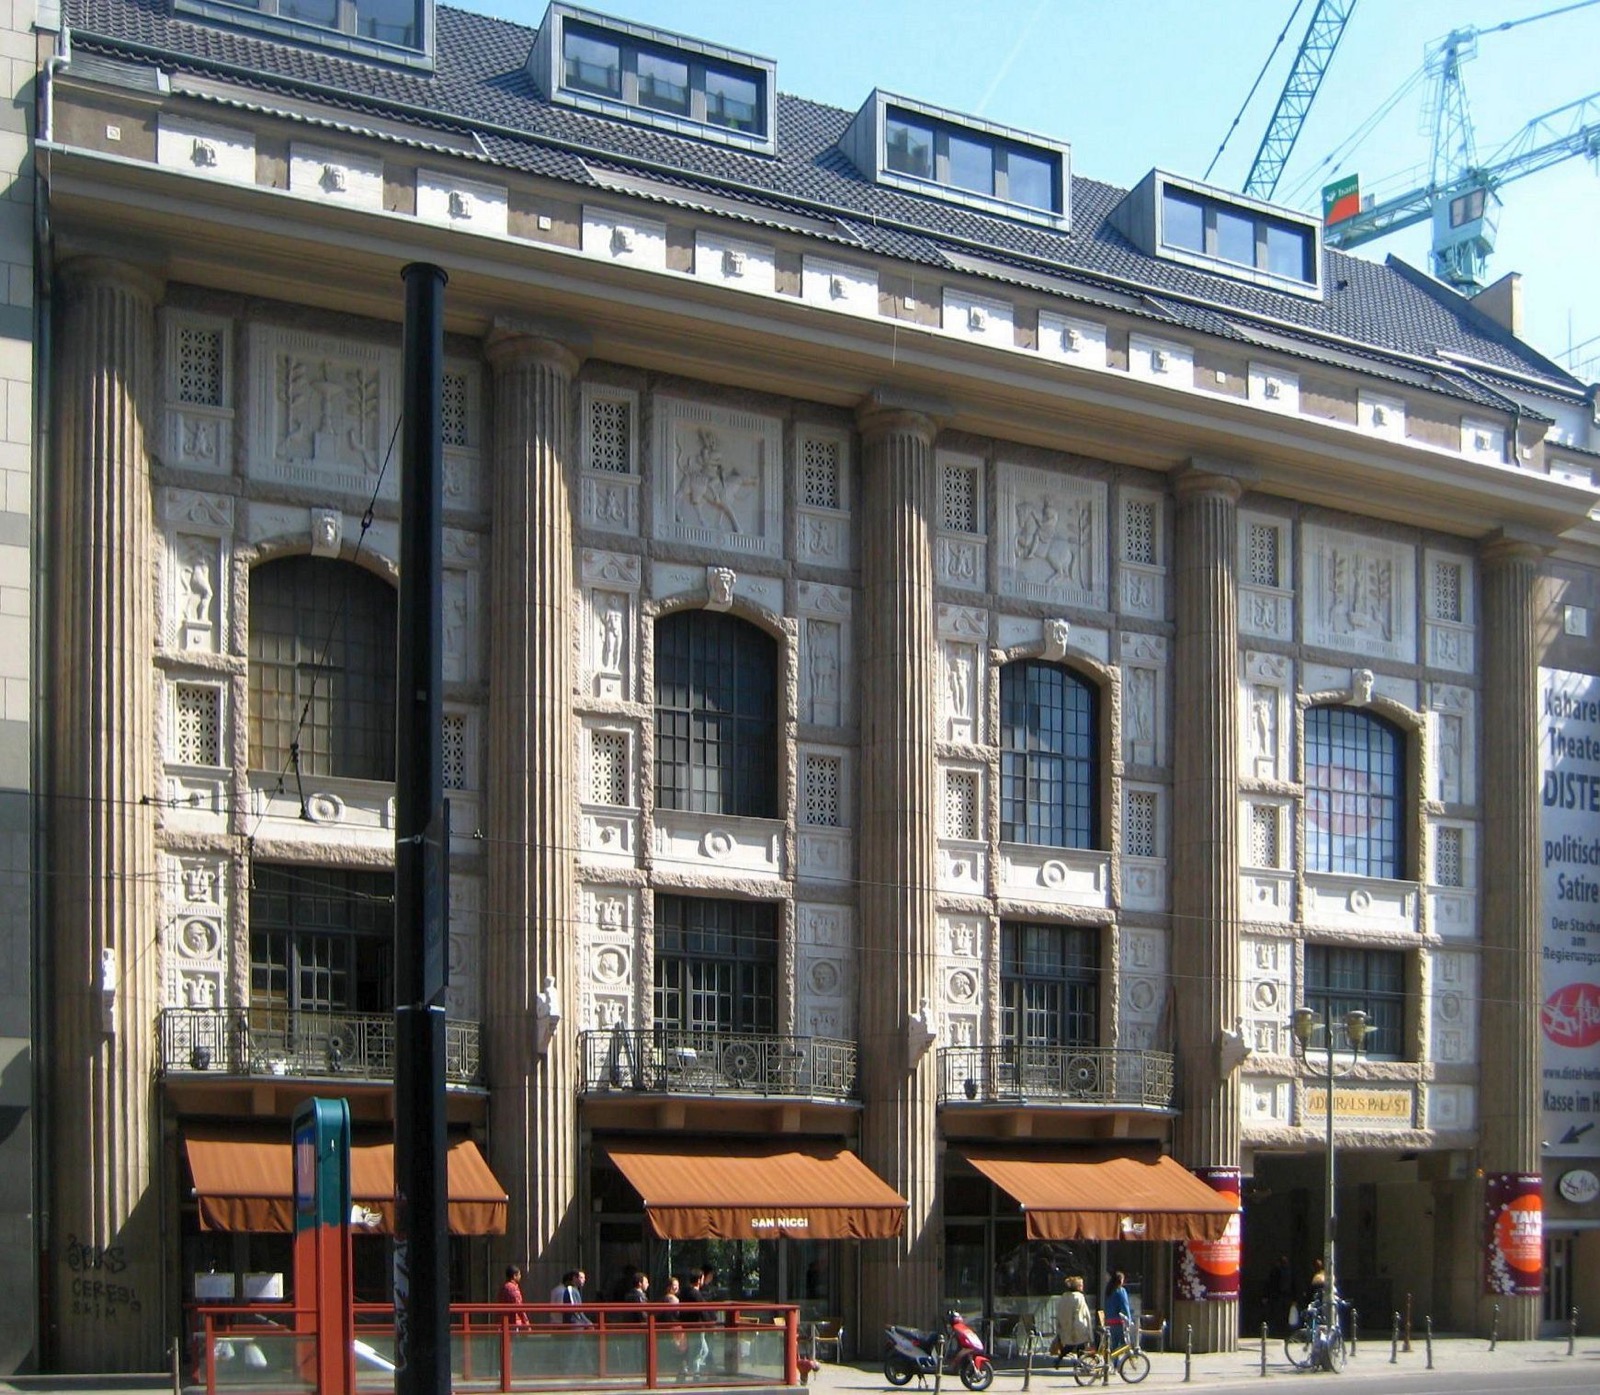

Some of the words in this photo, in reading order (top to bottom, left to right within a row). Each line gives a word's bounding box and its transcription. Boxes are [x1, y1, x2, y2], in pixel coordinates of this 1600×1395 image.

[1557, 872, 1599, 904] Satire
[1551, 916, 1569, 931] Der
[1571, 936, 1586, 947] am
[1543, 1089, 1574, 1112] Kasse
[1575, 1089, 1590, 1112] im
[751, 1217, 775, 1228] SAN
[777, 1217, 809, 1228] NICCI
